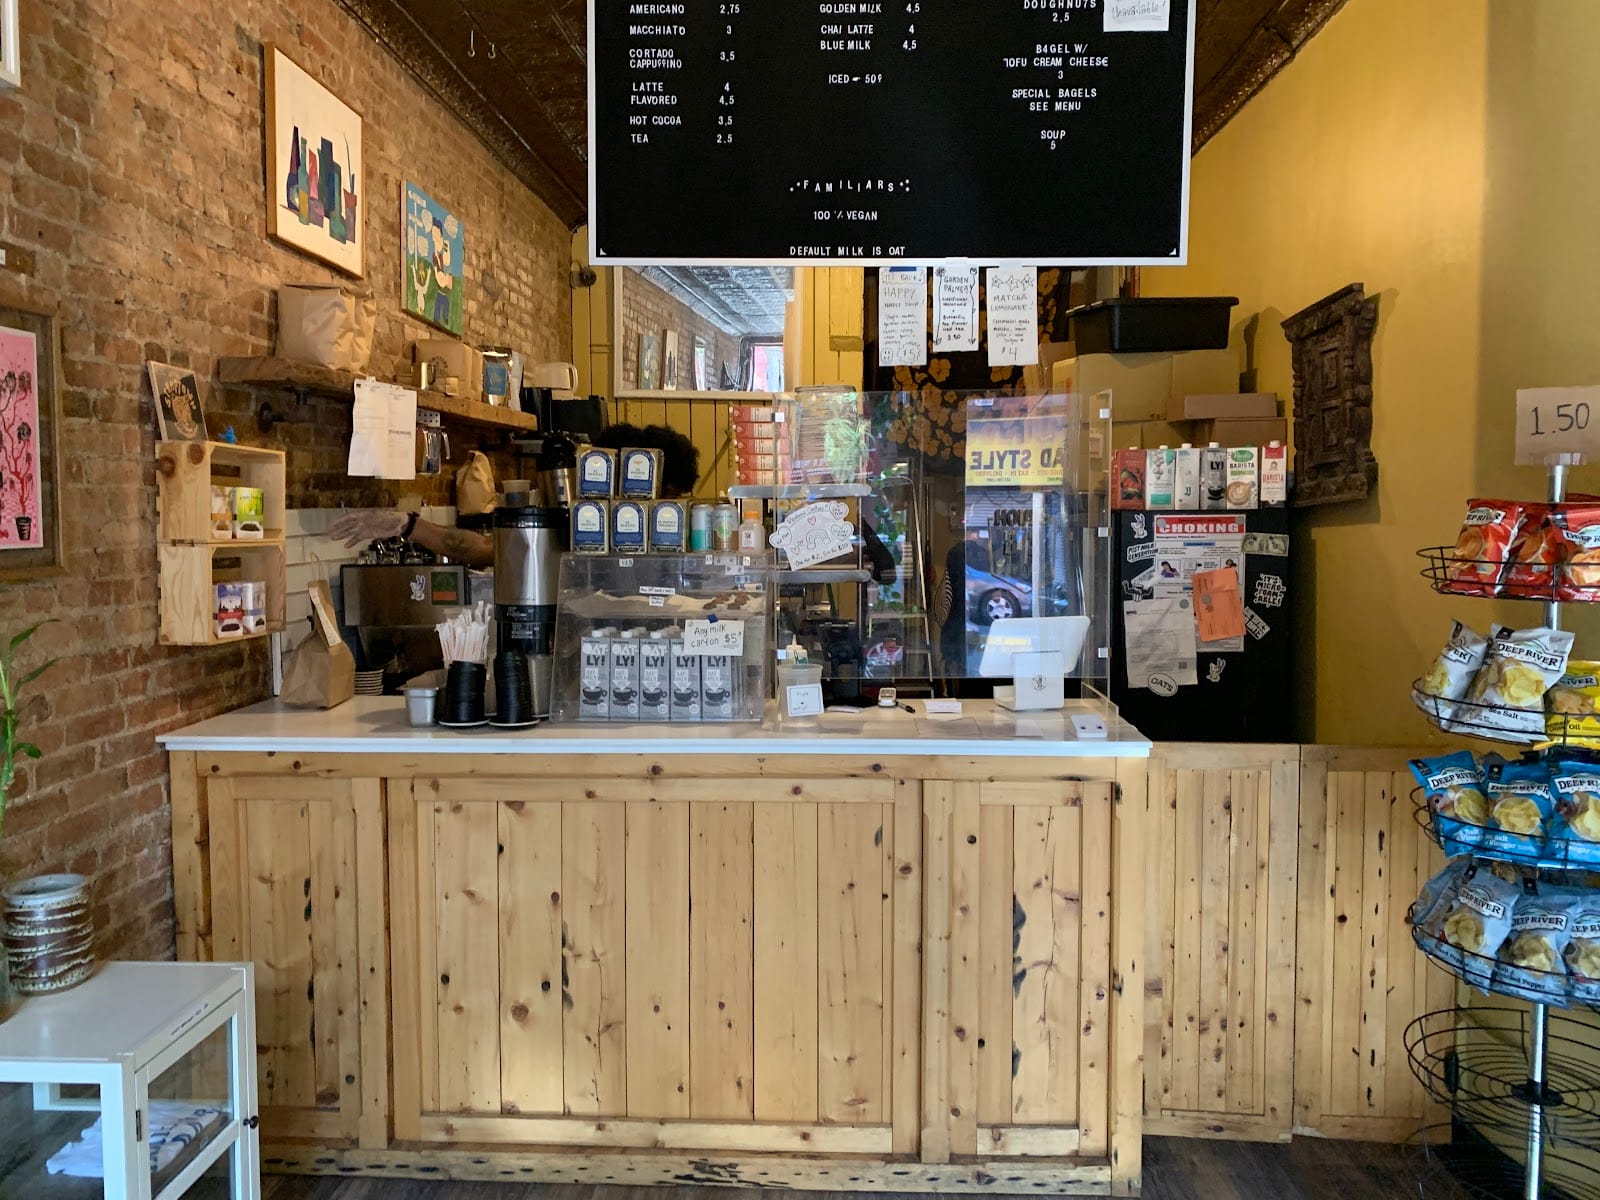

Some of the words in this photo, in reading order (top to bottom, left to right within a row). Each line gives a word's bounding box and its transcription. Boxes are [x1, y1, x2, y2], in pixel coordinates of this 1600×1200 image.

[819, 3, 856, 13] GOLDEN
[859, 3, 882, 13] MILK
[906, 3, 920, 14] 4.5
[1052, 12, 1070, 23] 2.5
[629, 25, 686, 35] MACCHIATO
[726, 25, 732, 35] 3
[908, 24, 914, 34] 4
[820, 40, 844, 50] BLUE
[847, 40, 871, 50] MILK
[902, 40, 917, 51] 4.5
[629, 49, 674, 58] CORTADO
[720, 51, 735, 62] 3.5
[1033, 57, 1062, 67] CREAM
[828, 74, 850, 84] ICED
[1058, 70, 1064, 79] 3
[632, 82, 663, 92] LATTE
[724, 82, 730, 92] 4
[1012, 88, 1051, 99] SPECIAL
[1058, 88, 1097, 98] BAGELS
[630, 95, 678, 105] FLAVORED
[719, 95, 735, 106] 4.5
[1029, 102, 1049, 111] SEE
[1055, 101, 1081, 111] MENU
[629, 115, 648, 125] HOT
[652, 115, 682, 126] COCOA
[718, 115, 733, 126] 3.5
[630, 133, 649, 144] TEA
[716, 133, 733, 144] 2.5
[1040, 130, 1066, 139] SOUP
[1051, 141, 1056, 150] 5
[813, 210, 831, 220] 100
[846, 210, 878, 221] VEGAN
[789, 246, 831, 256] DEFAULT
[837, 246, 864, 256] MILK
[872, 246, 882, 255] IS
[889, 246, 905, 256] OAT
[884, 287, 917, 299] HAPPY
[993, 293, 1027, 302] MATCHA
[1530, 402, 1590, 436] 1.50
[1159, 523, 1239, 533] CHOKING
[694, 627, 708, 637] Any
[710, 624, 727, 633] milk
[691, 638, 719, 648] carton
[586, 655, 605, 666] LY!
[616, 655, 635, 666] LY!
[1497, 643, 1525, 655] DEEP
[1525, 650, 1558, 667] RIVER
[645, 655, 665, 667] LY!
[676, 656, 695, 667] LY!
[708, 656, 726, 667] LY!
[1151, 677, 1174, 692] OATS
[1503, 710, 1519, 719] Salt
[1431, 774, 1455, 787] DEEP
[1559, 779, 1587, 790] DEEP
[1475, 897, 1501, 914] RIVER
[1530, 917, 1564, 927] RIVER
